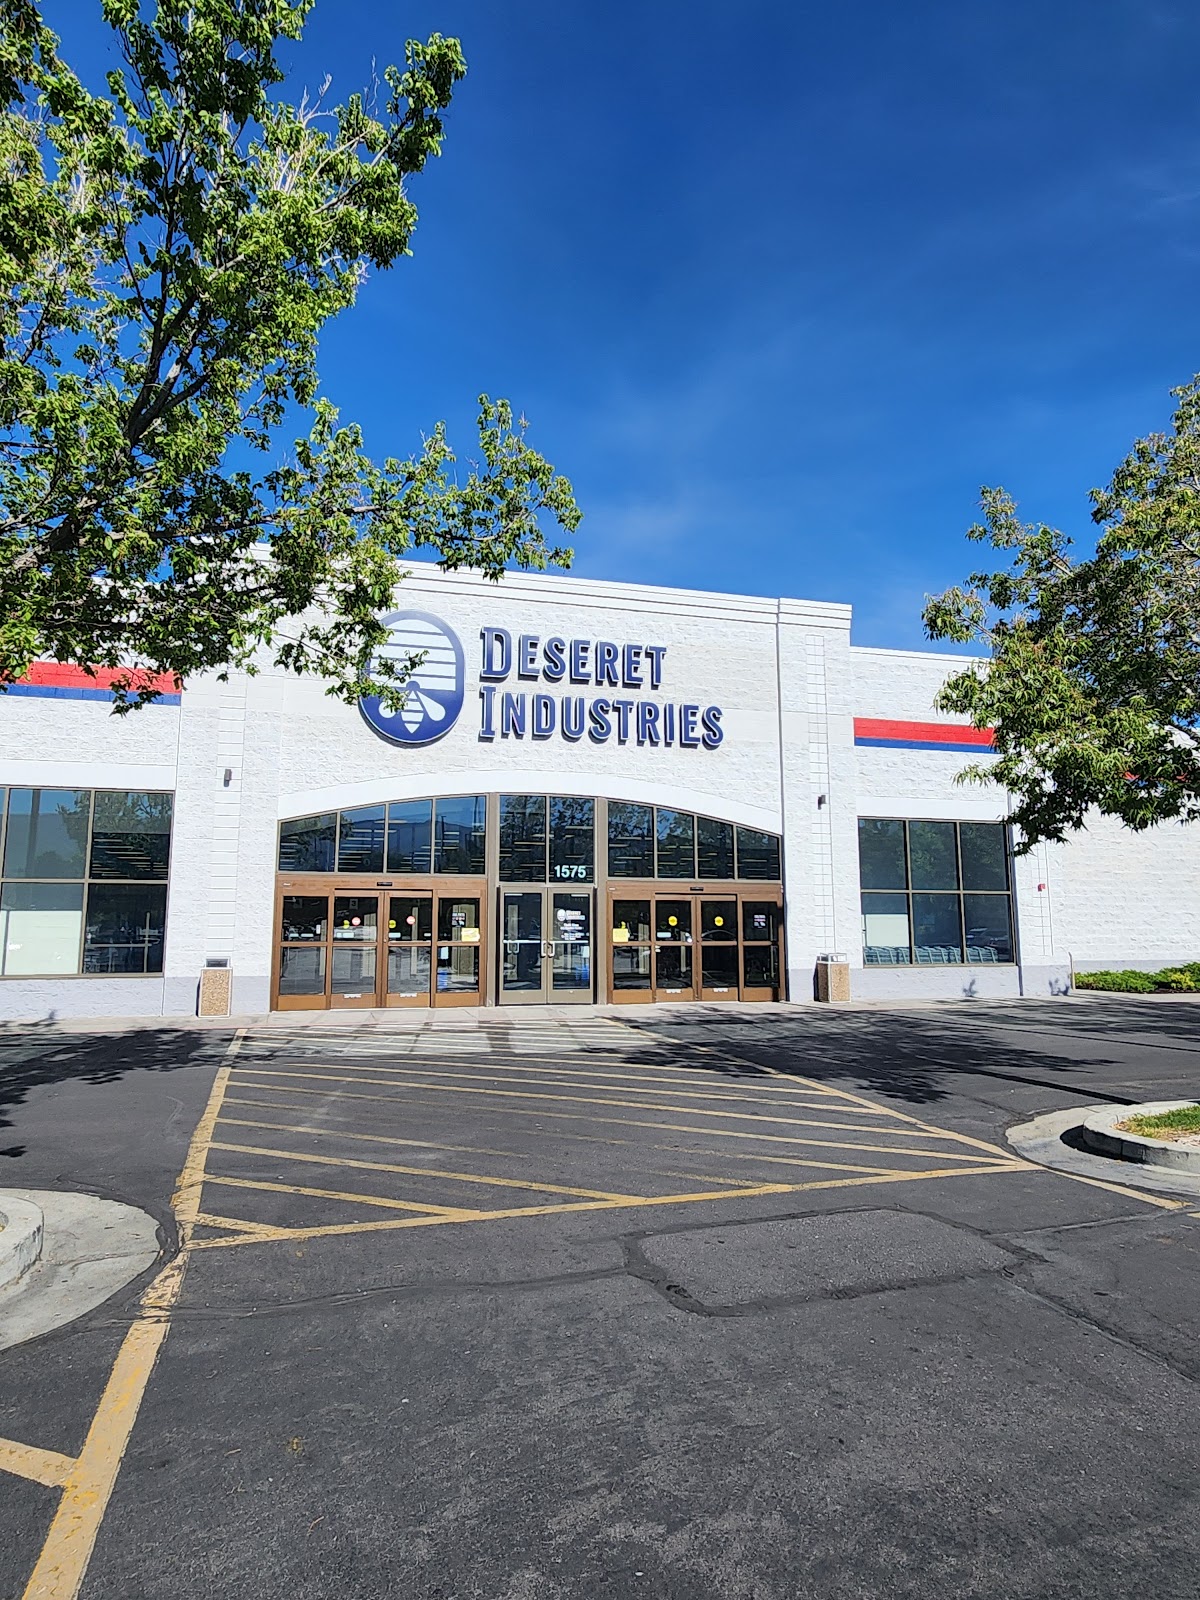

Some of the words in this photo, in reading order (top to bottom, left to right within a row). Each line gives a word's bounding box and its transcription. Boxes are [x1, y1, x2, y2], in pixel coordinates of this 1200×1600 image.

[480, 626, 667, 689] DESERET
[478, 685, 724, 749] INDUSTRIES
[554, 864, 586, 878] 1575
